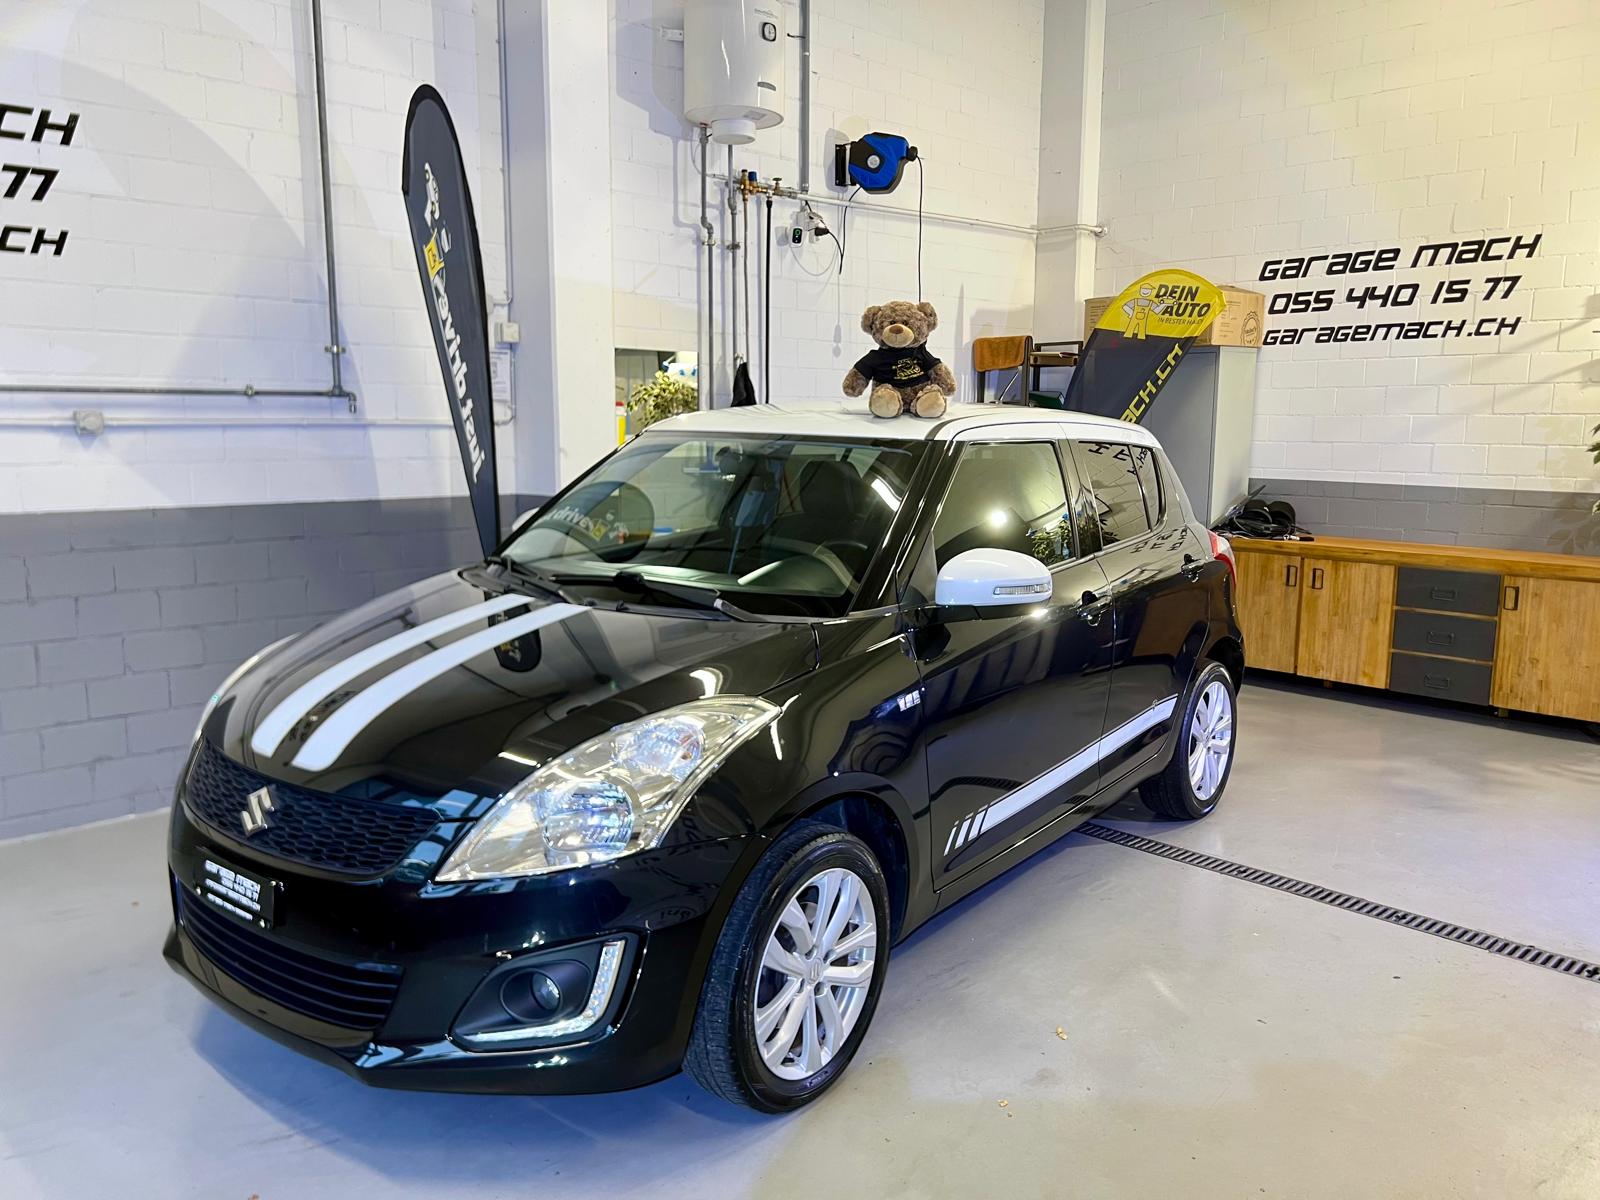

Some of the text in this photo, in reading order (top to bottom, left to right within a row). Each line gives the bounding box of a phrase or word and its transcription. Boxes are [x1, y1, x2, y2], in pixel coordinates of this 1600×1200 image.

[2, 164, 59, 201] 77
[1155, 284, 1199, 301] DEIN
[1268, 275, 1523, 315] 055 440 15 77
[1161, 302, 1211, 318] AUTO
